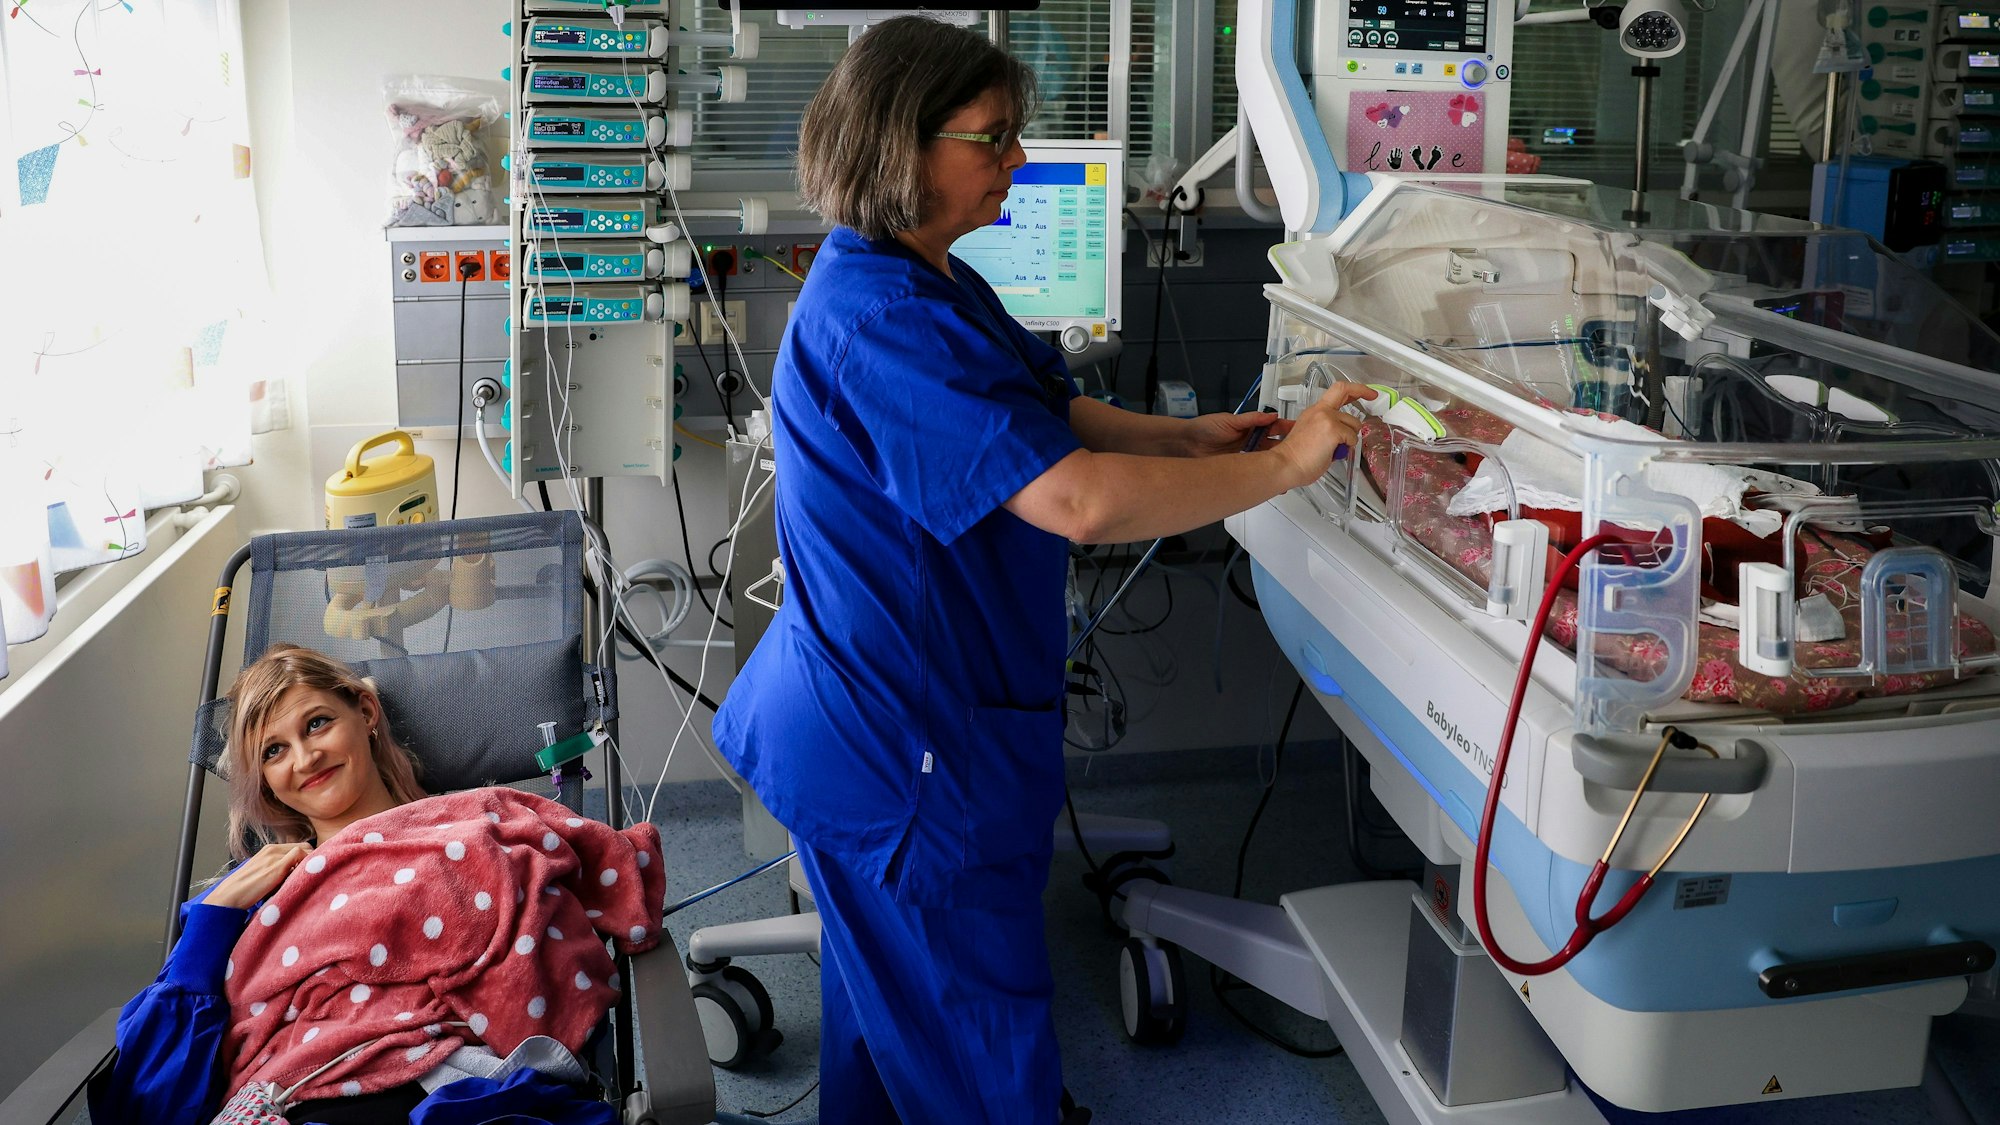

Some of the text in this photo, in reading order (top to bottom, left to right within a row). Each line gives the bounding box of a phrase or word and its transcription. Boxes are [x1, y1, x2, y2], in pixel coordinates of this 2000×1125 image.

[1378, 6, 1387, 14] 59
[1426, 700, 1509, 789] Babyleo TN50
